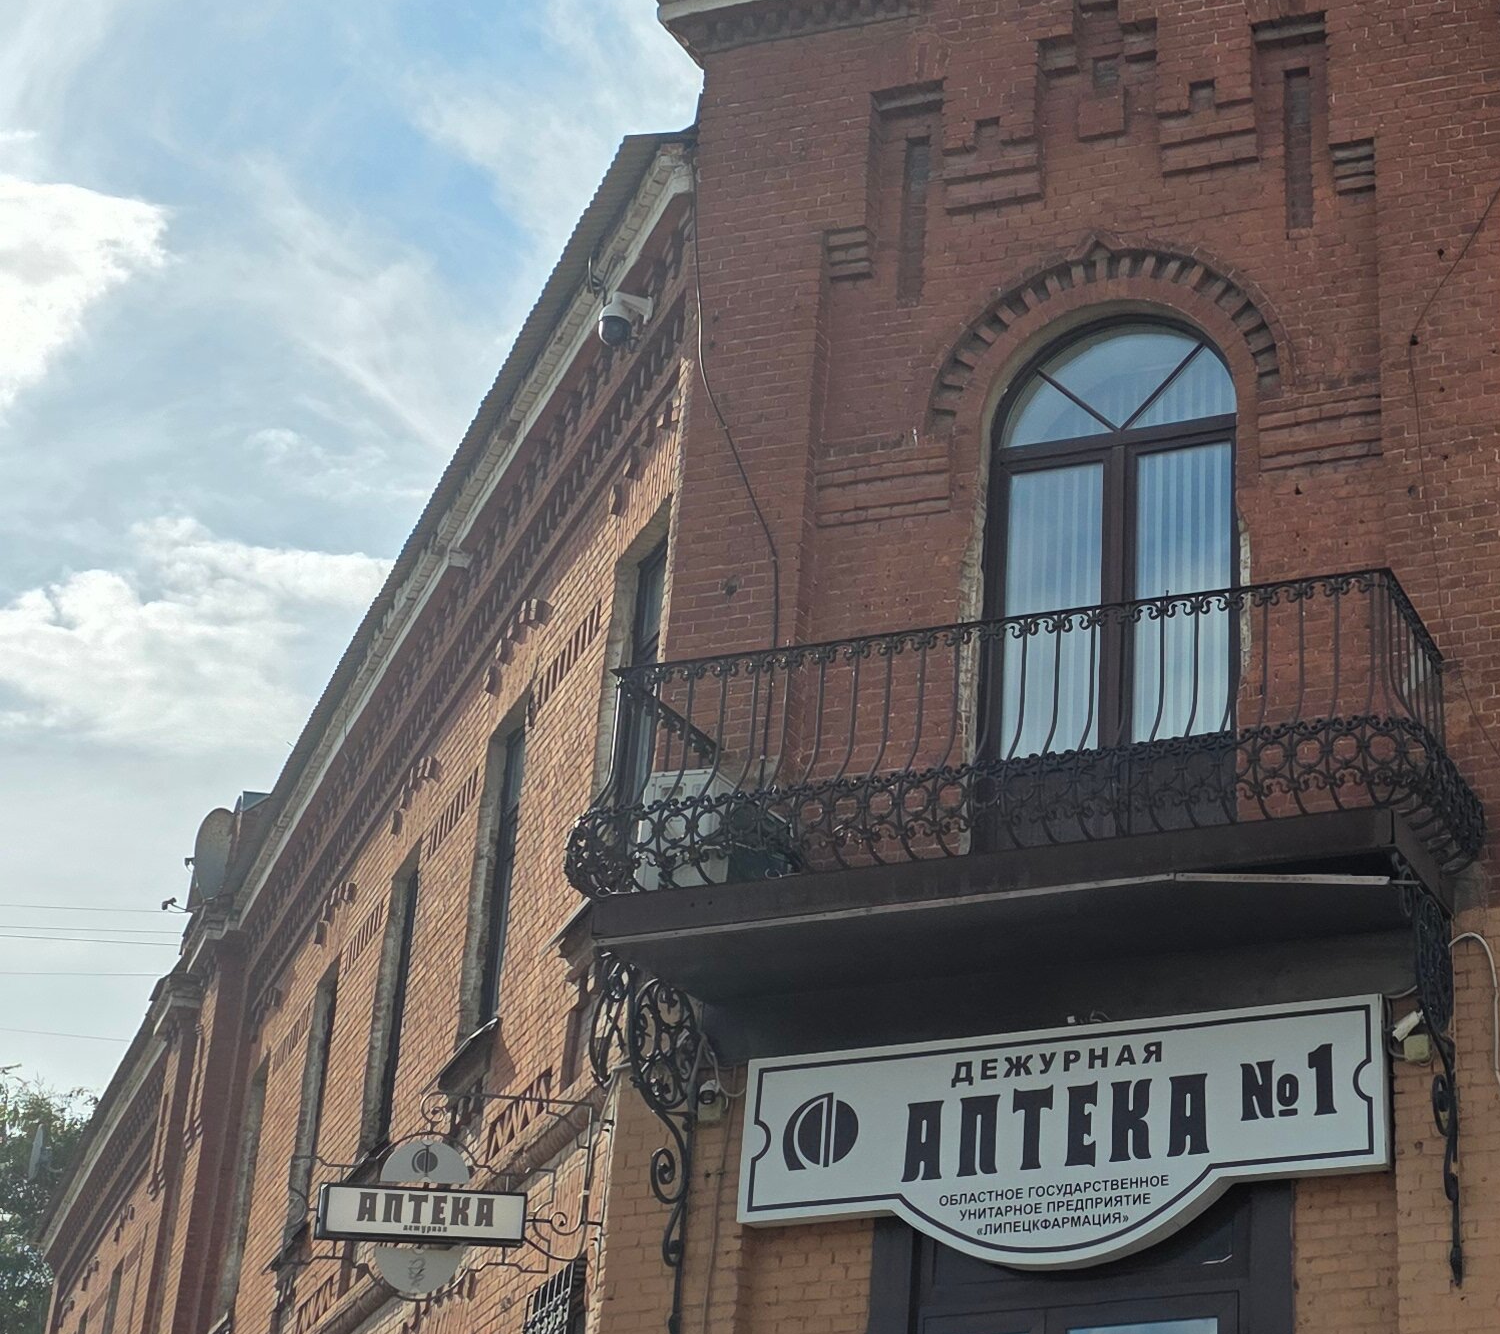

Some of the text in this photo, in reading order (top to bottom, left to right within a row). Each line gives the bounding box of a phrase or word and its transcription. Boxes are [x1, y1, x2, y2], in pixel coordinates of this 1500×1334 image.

[951, 1041, 1163, 1087] ДЕЖУРНАЯ
[901, 1073, 1210, 1182] АПТЕКА
[938, 1174, 1170, 1207] ОБЛАСТНОЕ ГОСУДАРСТВЕННОЕ
[959, 1192, 1152, 1221] УНИТАРНОЕ ПРЕДПРИЯТИЕ
[356, 1191, 495, 1227] АПТЕКА
[976, 1212, 1130, 1236] «ЛИПЕЦКФАРМАЦИЯ»
